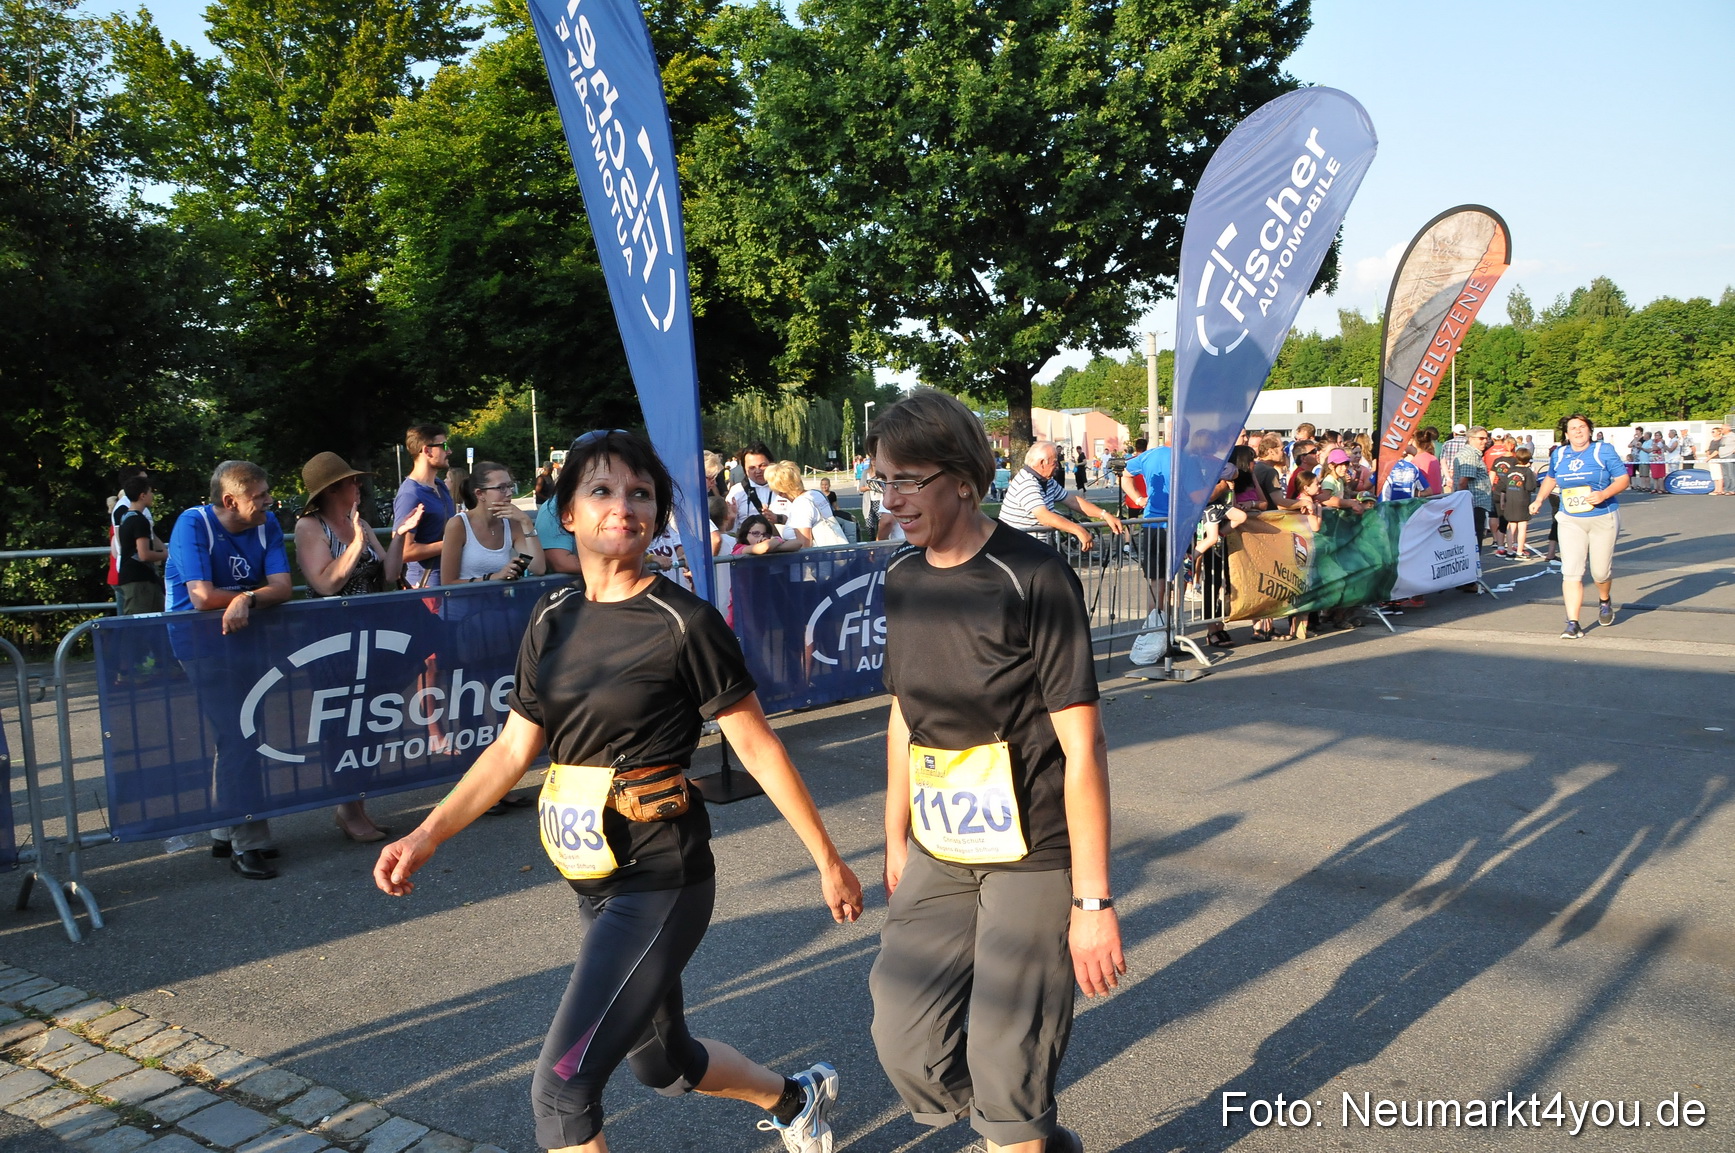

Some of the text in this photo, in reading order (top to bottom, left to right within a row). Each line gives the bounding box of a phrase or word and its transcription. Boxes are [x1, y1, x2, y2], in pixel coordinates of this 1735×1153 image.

[1219, 126, 1326, 324] Fischer
[1258, 156, 1341, 318] AUTOMOBILE
[1566, 496, 1587, 507] 292
[1434, 545, 1465, 561] Neumarkter
[856, 653, 884, 673] AU
[538, 802, 604, 851] 1083
[913, 787, 1012, 835] 1120
